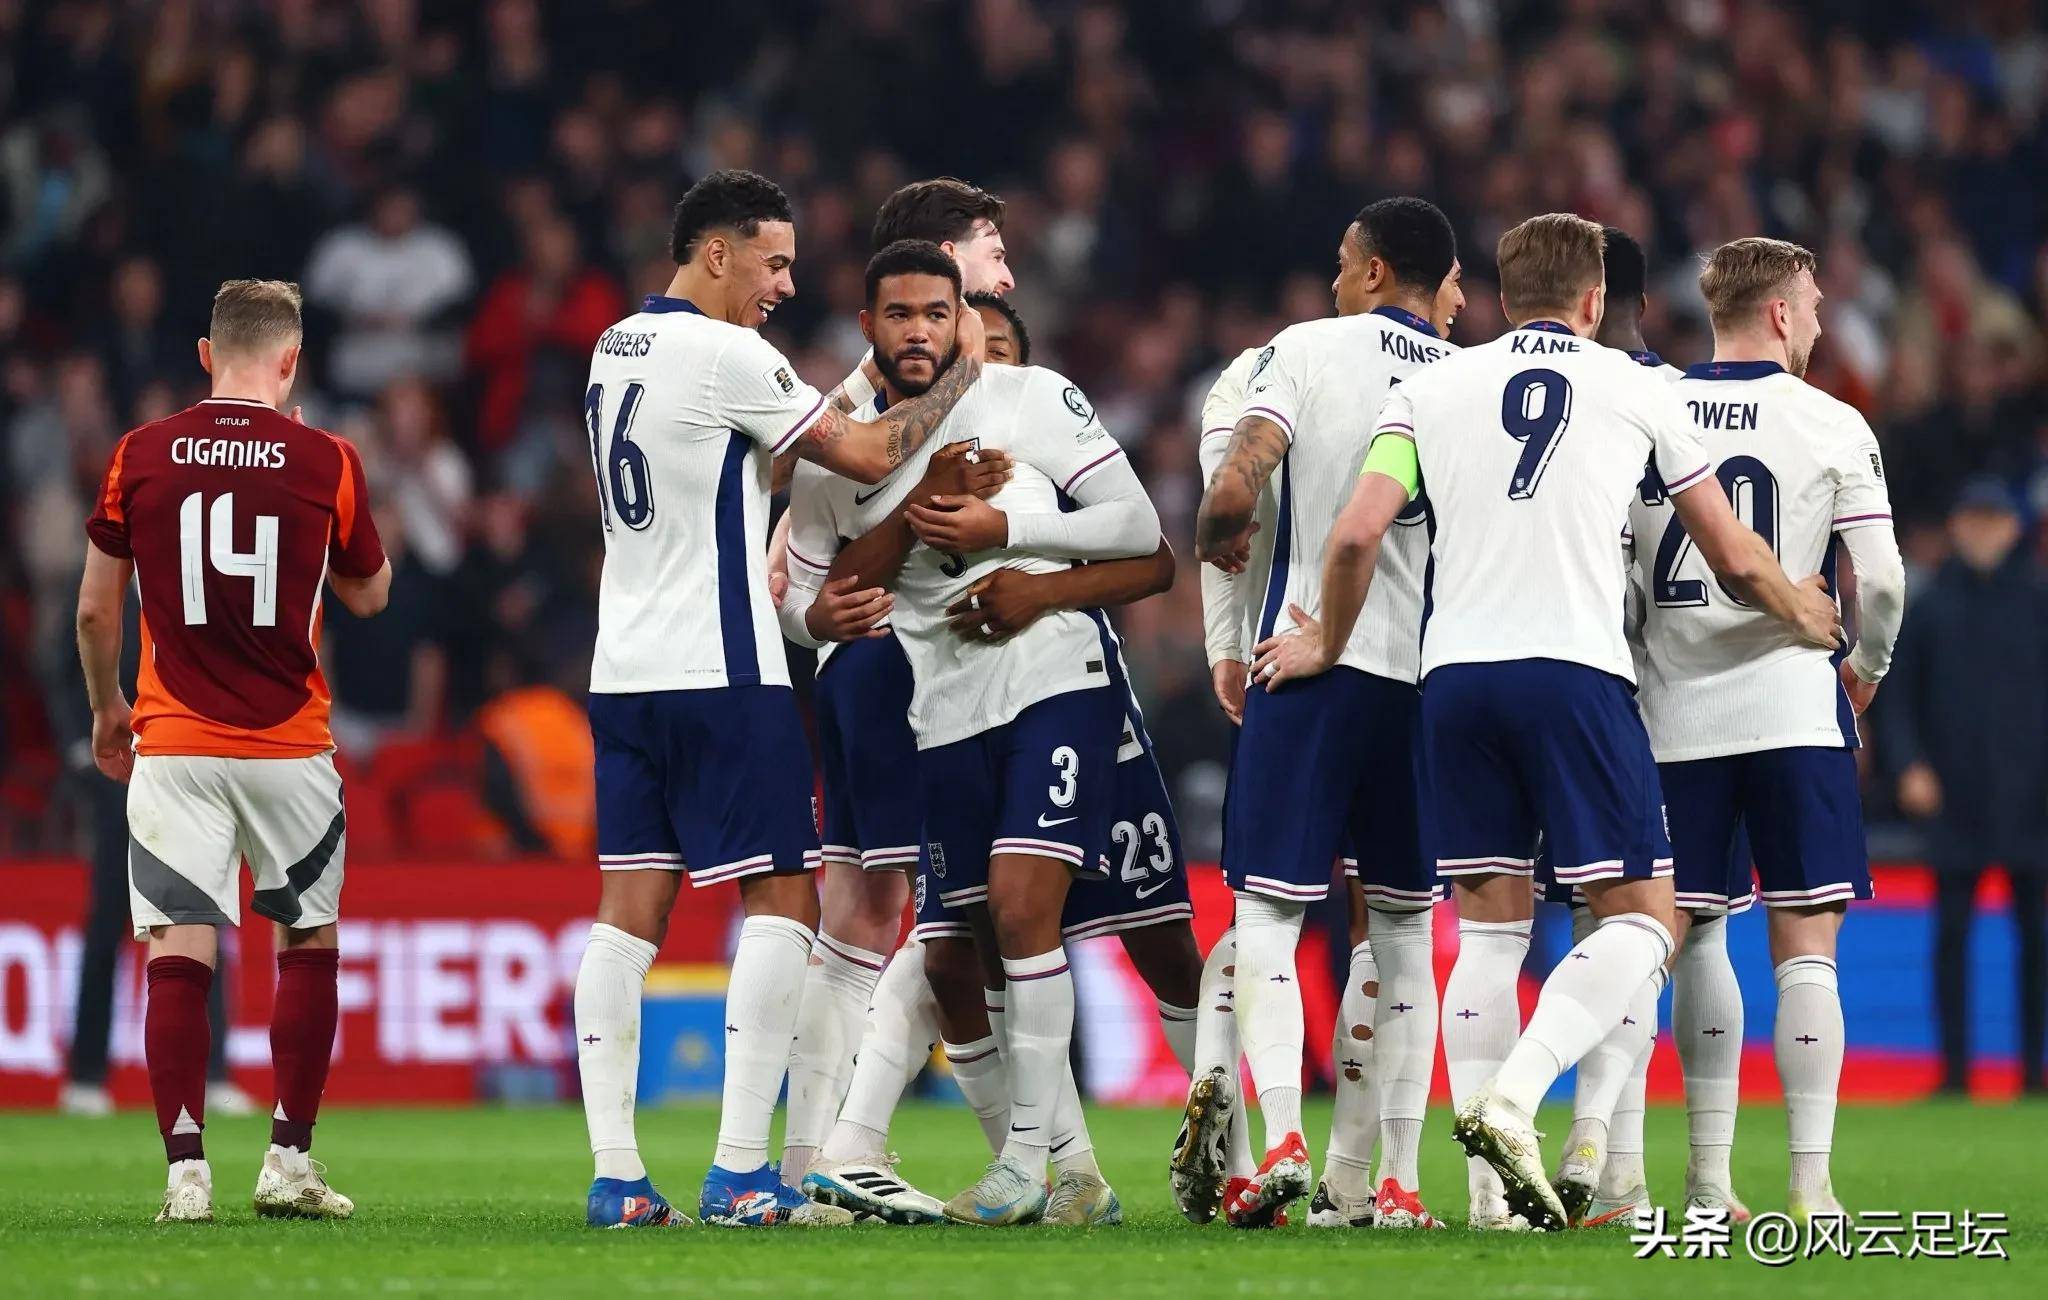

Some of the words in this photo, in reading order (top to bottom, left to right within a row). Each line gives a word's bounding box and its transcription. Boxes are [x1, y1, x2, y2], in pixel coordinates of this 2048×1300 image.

[595, 328, 657, 357] ROGERS
[1380, 330, 1451, 363] KONS
[1511, 335, 1580, 354] KANE
[1501, 368, 1573, 501] 9
[1686, 400, 1759, 430] OWEN
[171, 437, 287, 470] CIGAŅIKS
[586, 383, 655, 532] 16
[180, 491, 279, 627] 14
[1049, 745, 1079, 808] 3
[1111, 812, 1173, 883] 23
